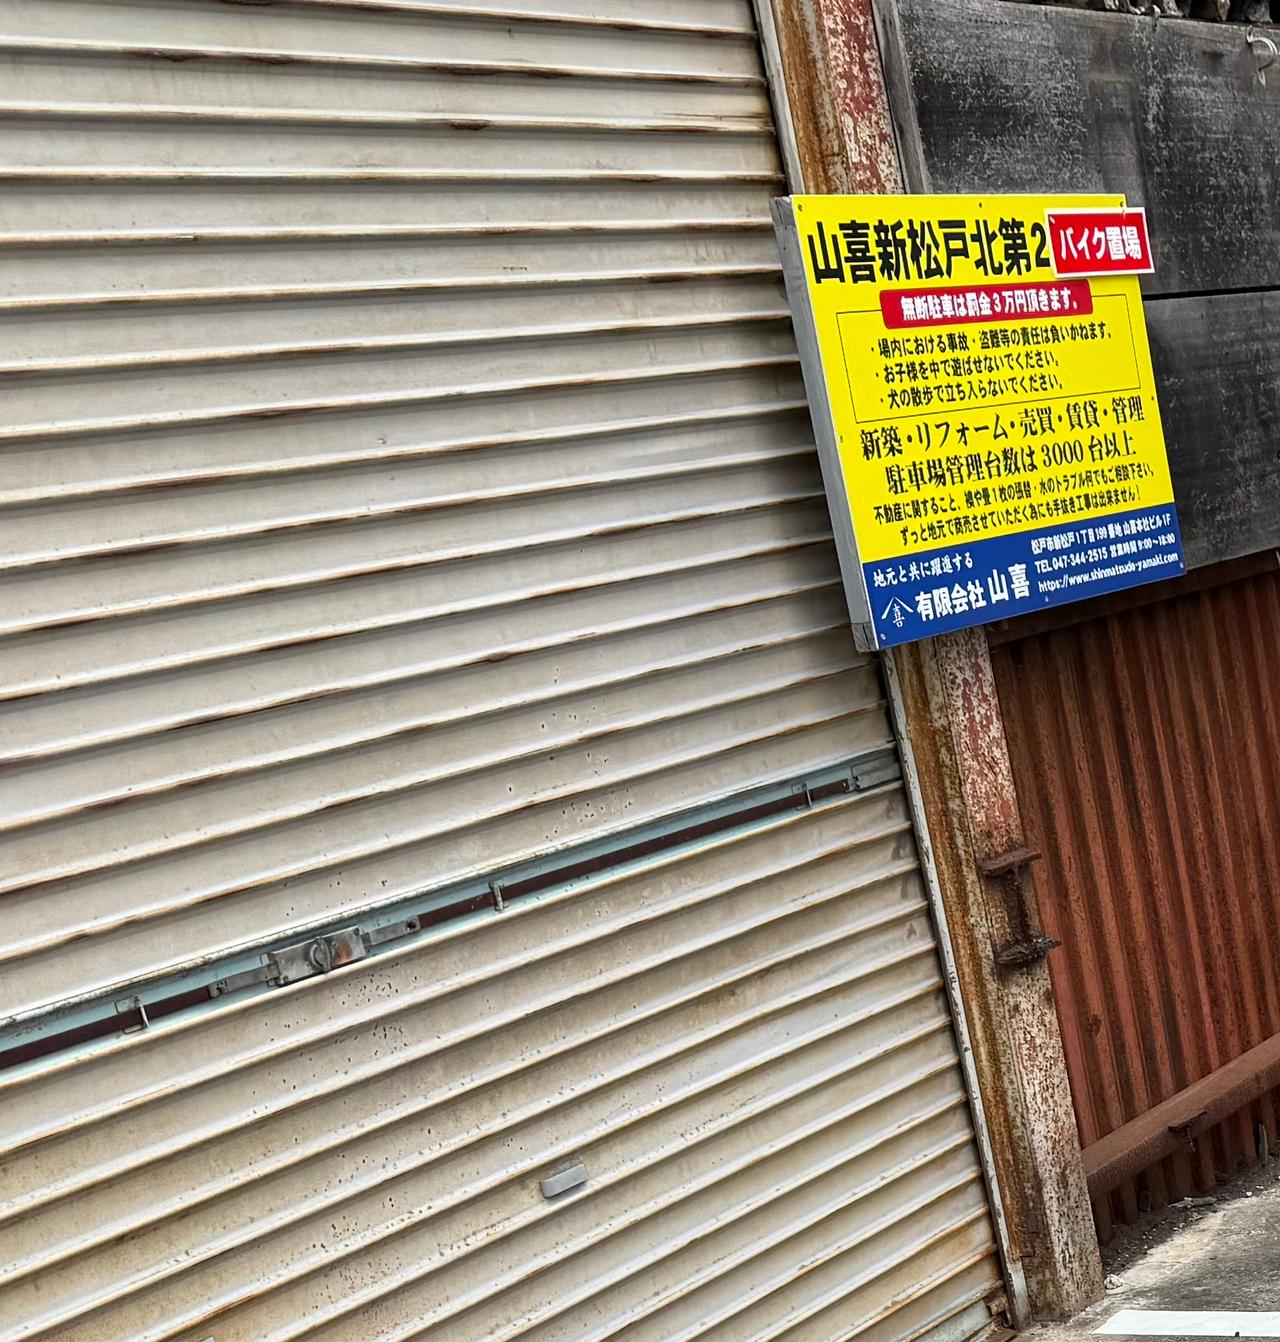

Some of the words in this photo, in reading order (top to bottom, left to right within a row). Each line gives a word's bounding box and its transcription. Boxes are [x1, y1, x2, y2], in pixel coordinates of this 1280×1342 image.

[807, 217, 1050, 284] 山喜新松戸北第2
[1059, 225, 1143, 262] バイク置場
